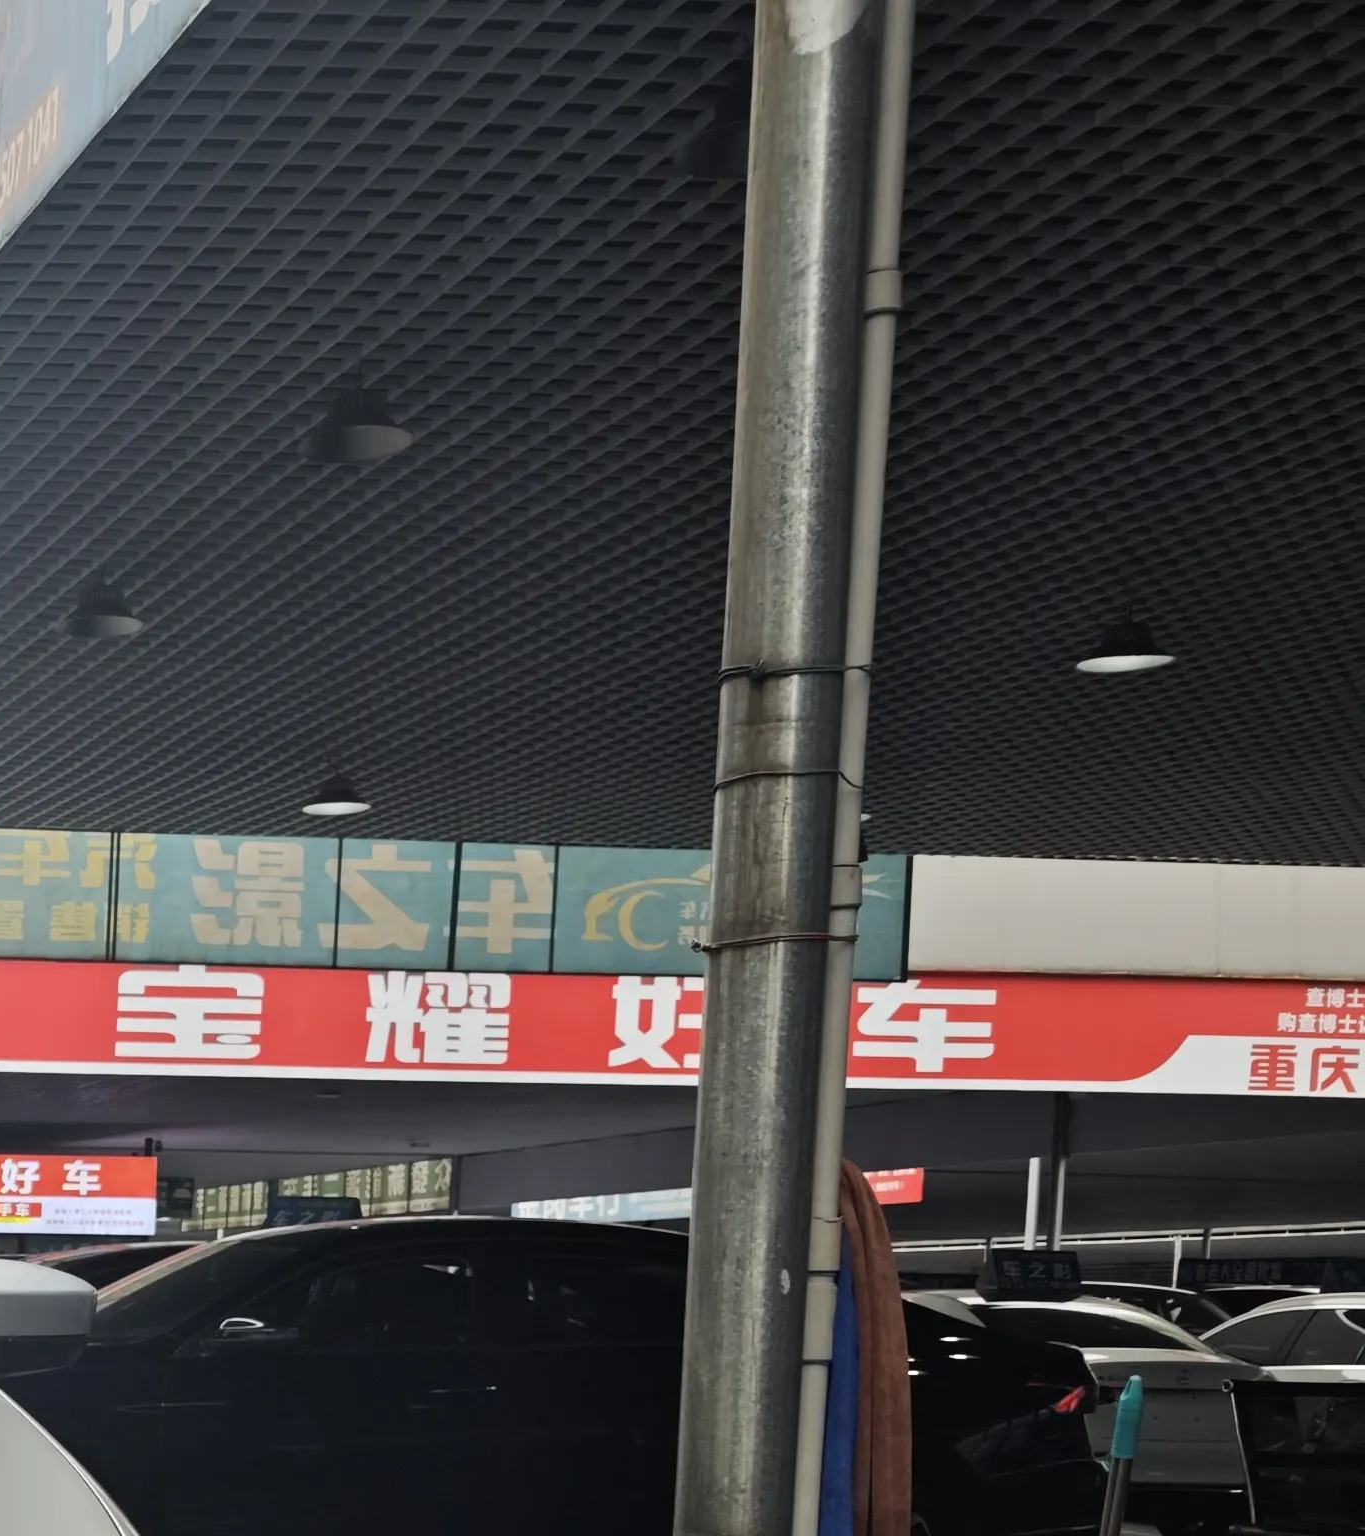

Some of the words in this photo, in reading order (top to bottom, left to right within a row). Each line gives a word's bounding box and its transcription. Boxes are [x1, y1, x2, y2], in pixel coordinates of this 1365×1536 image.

[114, 965, 997, 1073] 宝耀好车
[1248, 1043, 1361, 1094] 重庆
